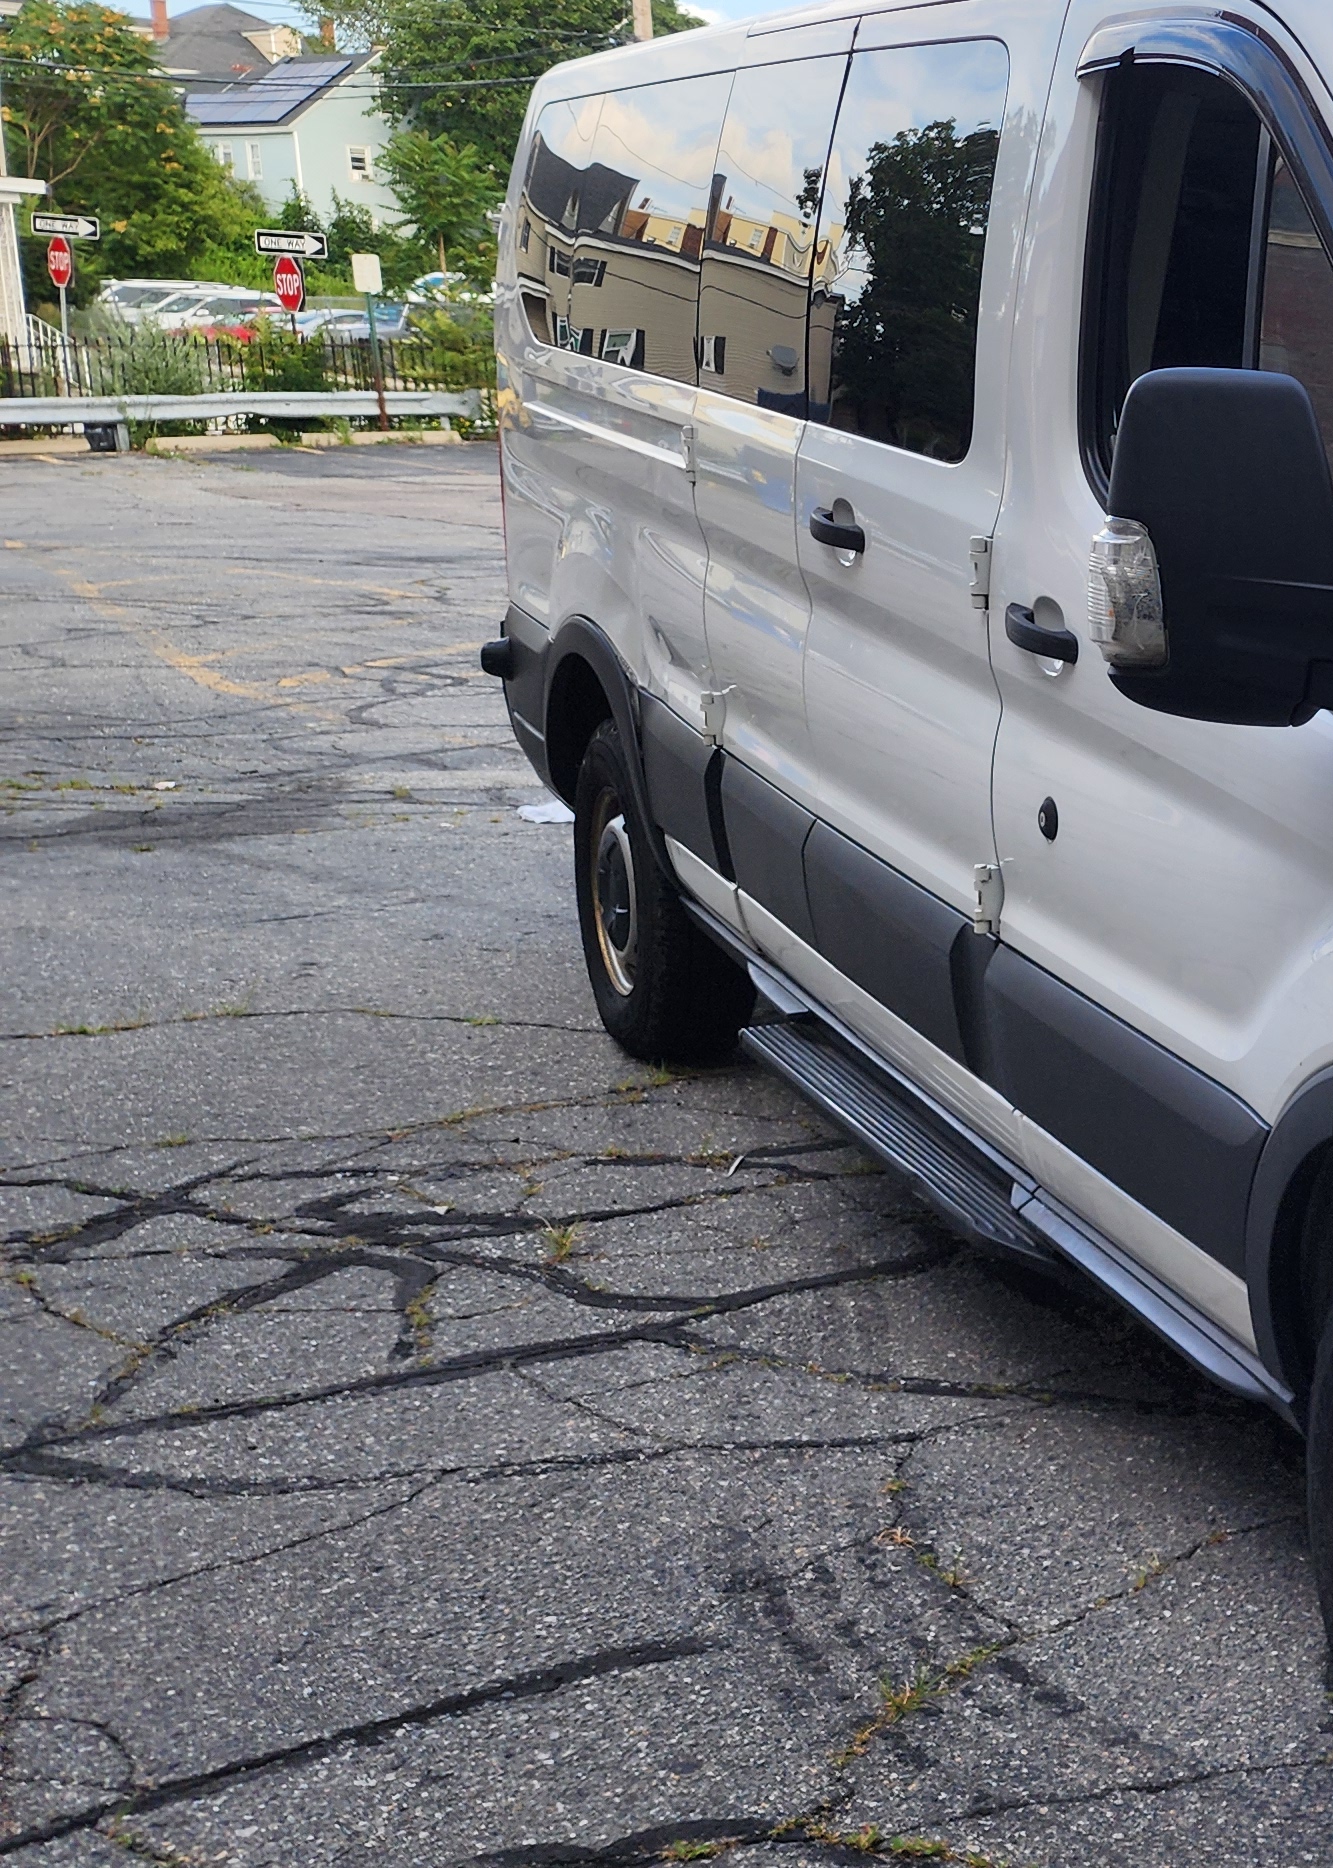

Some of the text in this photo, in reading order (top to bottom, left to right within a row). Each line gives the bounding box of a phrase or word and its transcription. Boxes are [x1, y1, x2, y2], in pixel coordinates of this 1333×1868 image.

[39, 220, 79, 231] ONE WAY
[264, 237, 305, 249] ONE WAY
[50, 250, 69, 271] STOP
[276, 273, 300, 296] STOP
